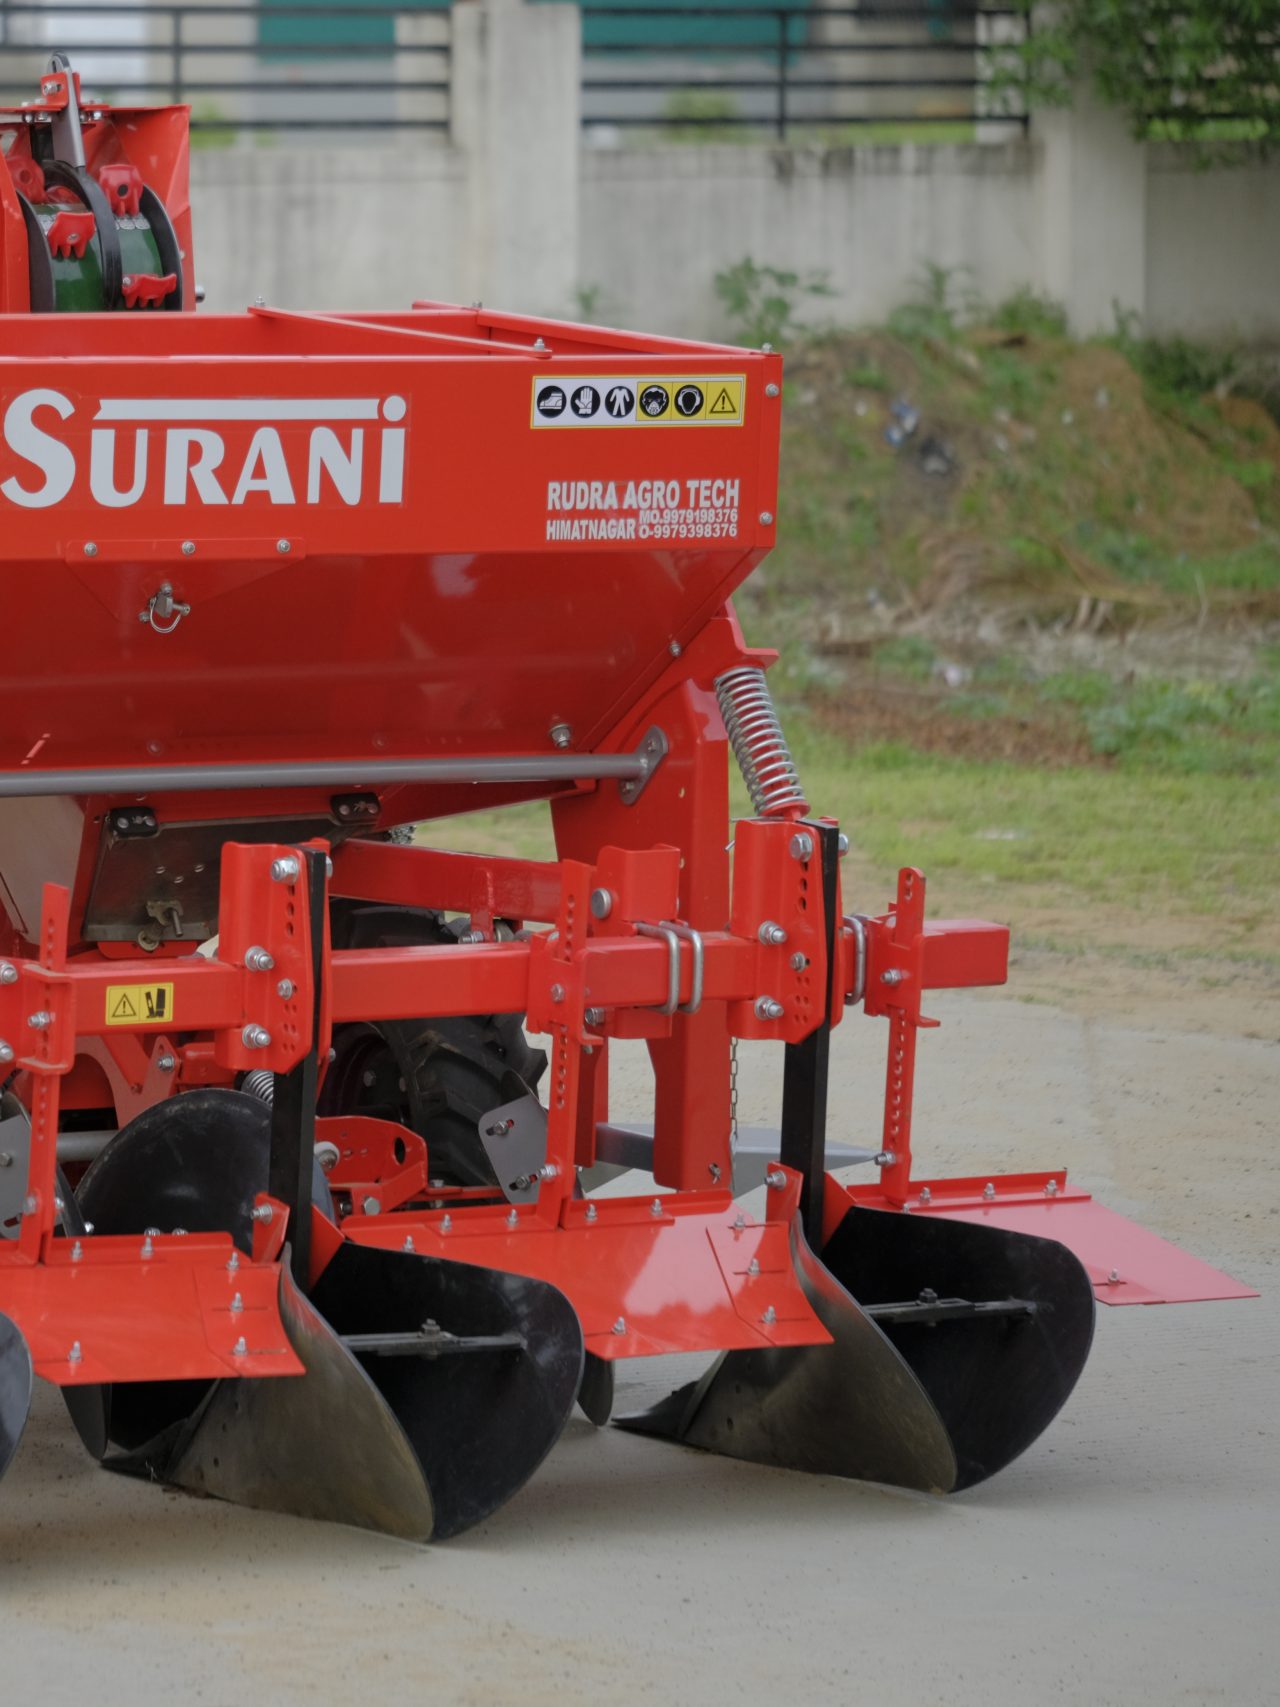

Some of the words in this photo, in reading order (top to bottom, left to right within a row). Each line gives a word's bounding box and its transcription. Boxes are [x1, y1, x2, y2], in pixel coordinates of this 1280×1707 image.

[547, 481, 618, 511] RUDRA
[622, 480, 680, 509] AGRO
[686, 479, 740, 508] TECH
[546, 518, 636, 541] HIMATNAGAR
